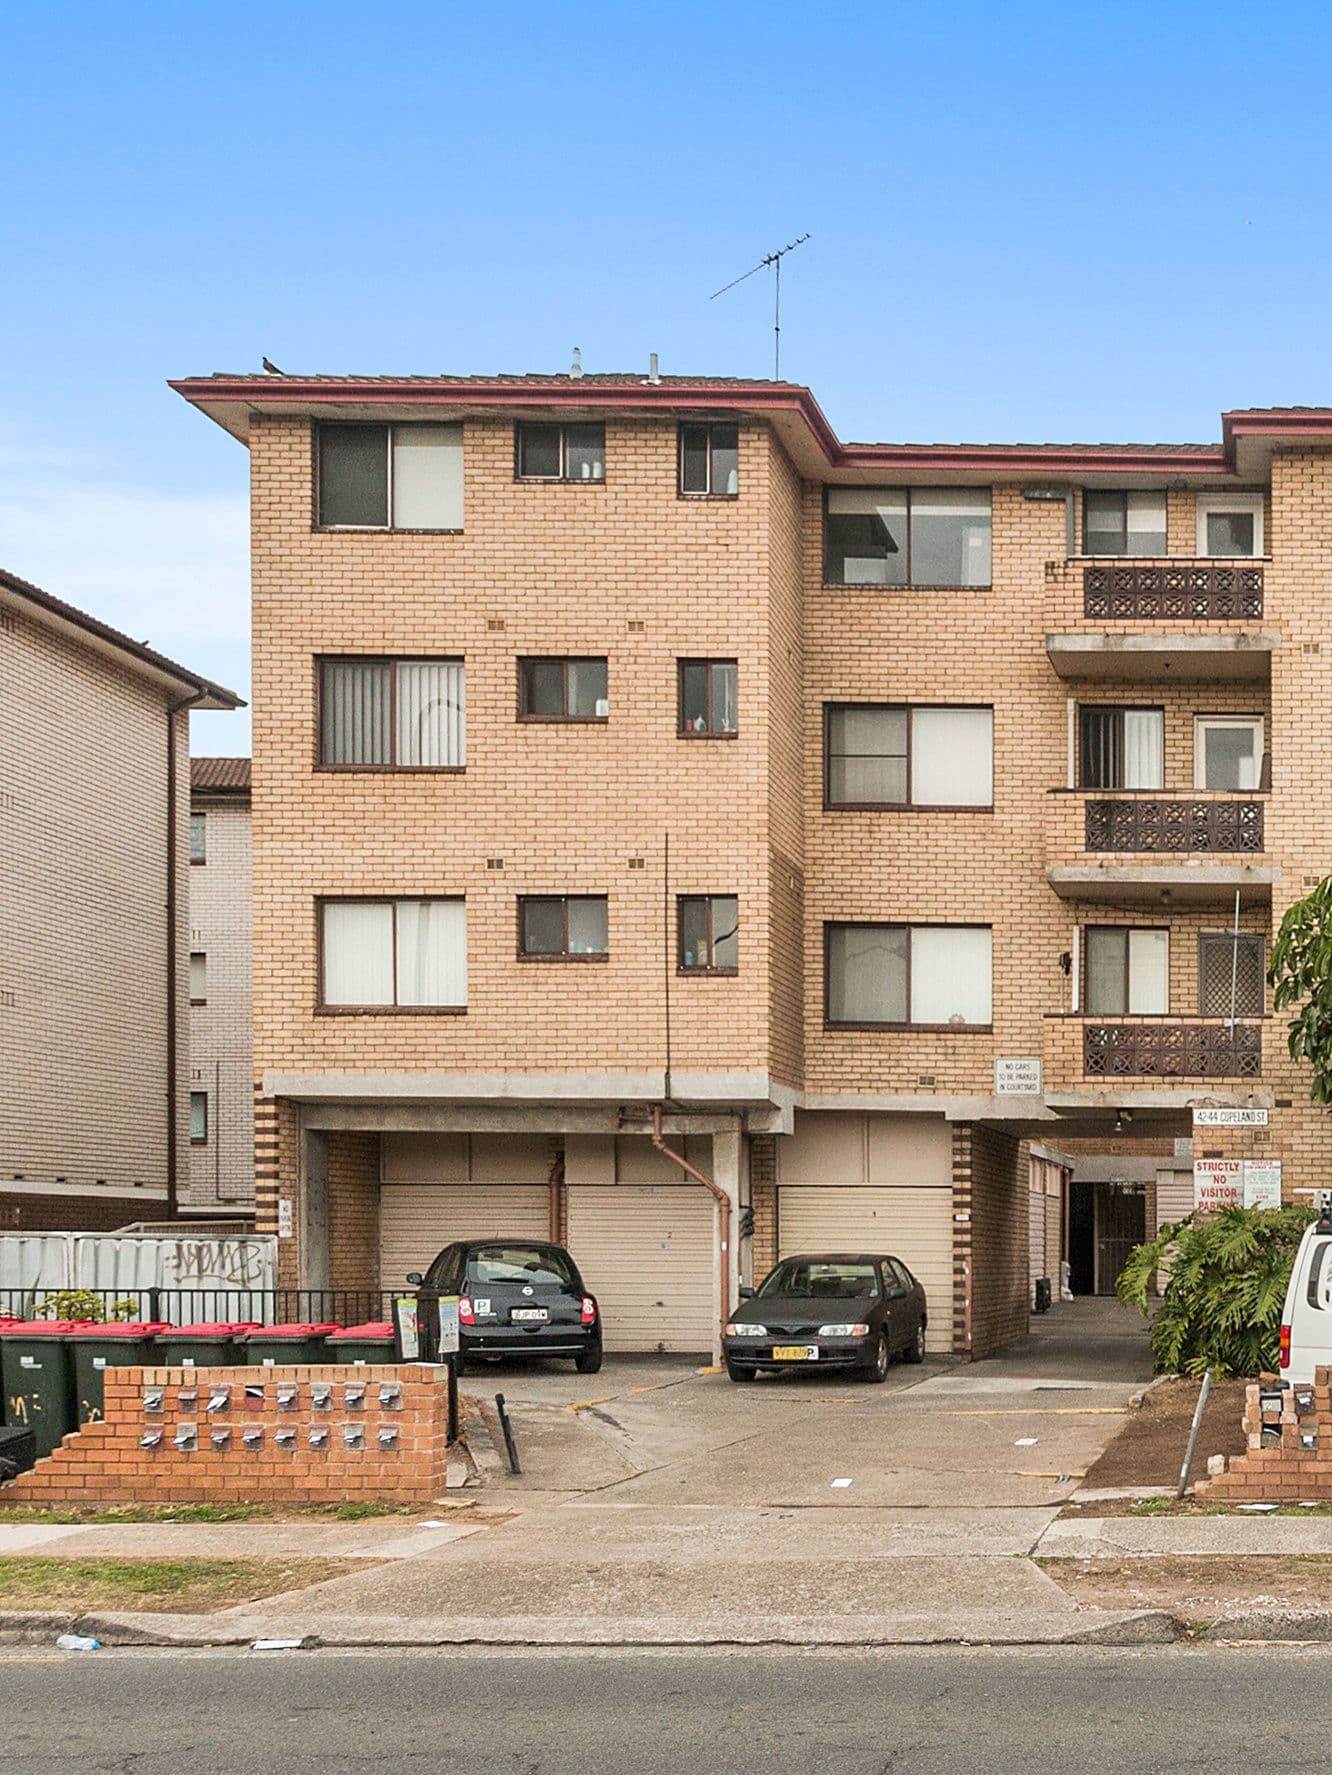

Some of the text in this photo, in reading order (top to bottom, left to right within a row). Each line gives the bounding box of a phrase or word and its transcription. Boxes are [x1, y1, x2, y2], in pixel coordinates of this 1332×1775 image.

[1220, 1111, 1256, 1122] COPELAND
[1196, 1162, 1240, 1172] STRICTLY
[1213, 1174, 1227, 1185] NO
[1200, 1188, 1237, 1198] VISITOR
